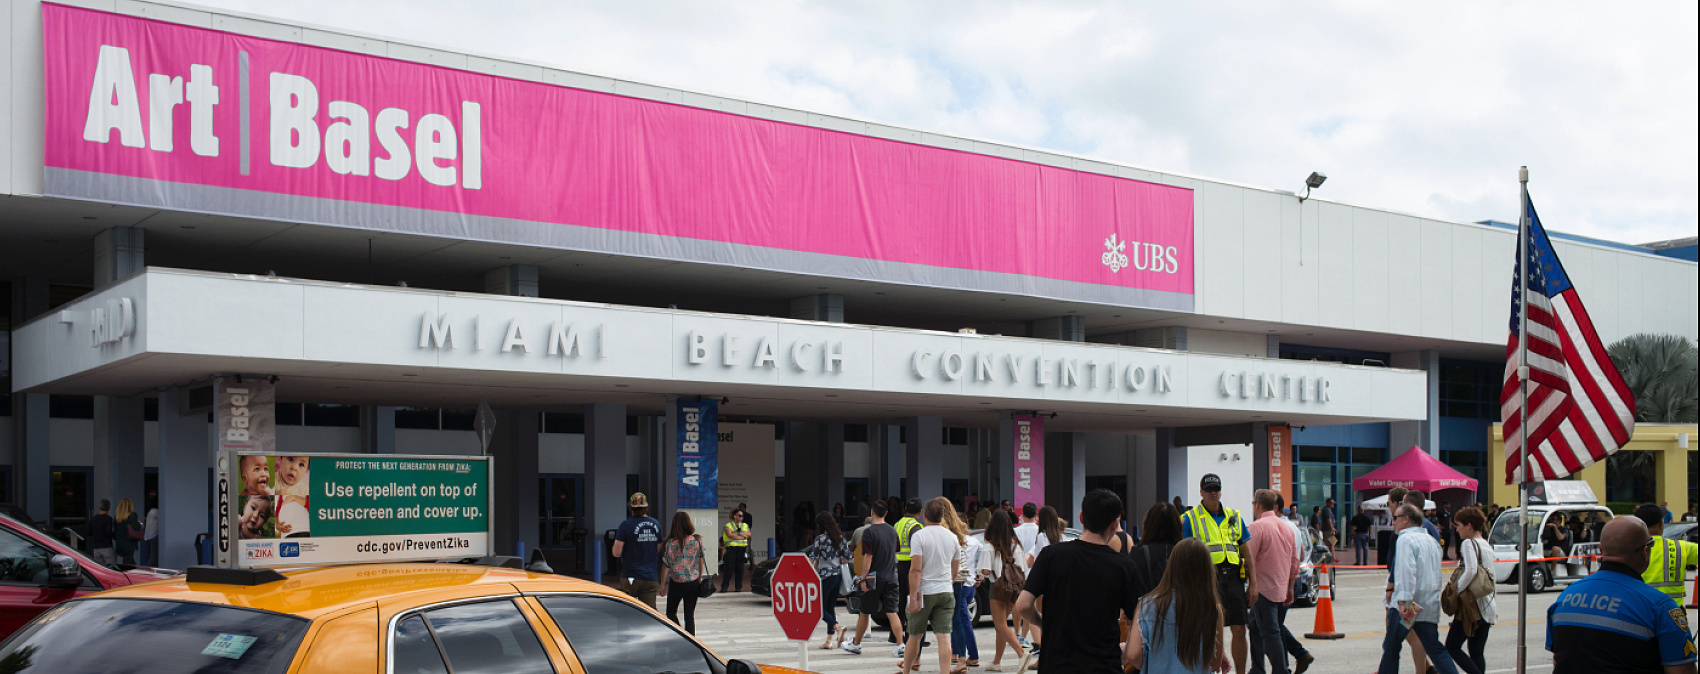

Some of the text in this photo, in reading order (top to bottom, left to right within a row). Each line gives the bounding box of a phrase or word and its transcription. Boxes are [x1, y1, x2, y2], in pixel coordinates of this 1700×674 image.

[83, 44, 482, 190] Art Basel
[1131, 240, 1178, 274] UBS
[418, 310, 1331, 403] MIAMI BEACH CONVENTION CENTER
[226, 387, 249, 442] Basel
[683, 407, 699, 487] Art Basel
[718, 431, 733, 443] asel
[335, 461, 366, 470] PROTECT
[367, 462, 380, 470] THE
[382, 462, 398, 470] NEXT
[399, 462, 436, 471] GENERATION
[438, 463, 454, 471] FROM
[1018, 420, 1031, 490] Art Basel
[1272, 432, 1281, 492] Art Basel
[325, 481, 478, 500] Use repellent on top of
[1387, 480, 1414, 488] Drop-off
[219, 481, 228, 550] VACANT
[318, 504, 483, 520] sunscreen and cover up.
[694, 517, 713, 527] UBS
[255, 549, 273, 558] ZIKA
[356, 537, 470, 554] cdc.gov/PreventZika
[775, 581, 818, 614] STOP
[1562, 593, 1622, 613] POLICE
